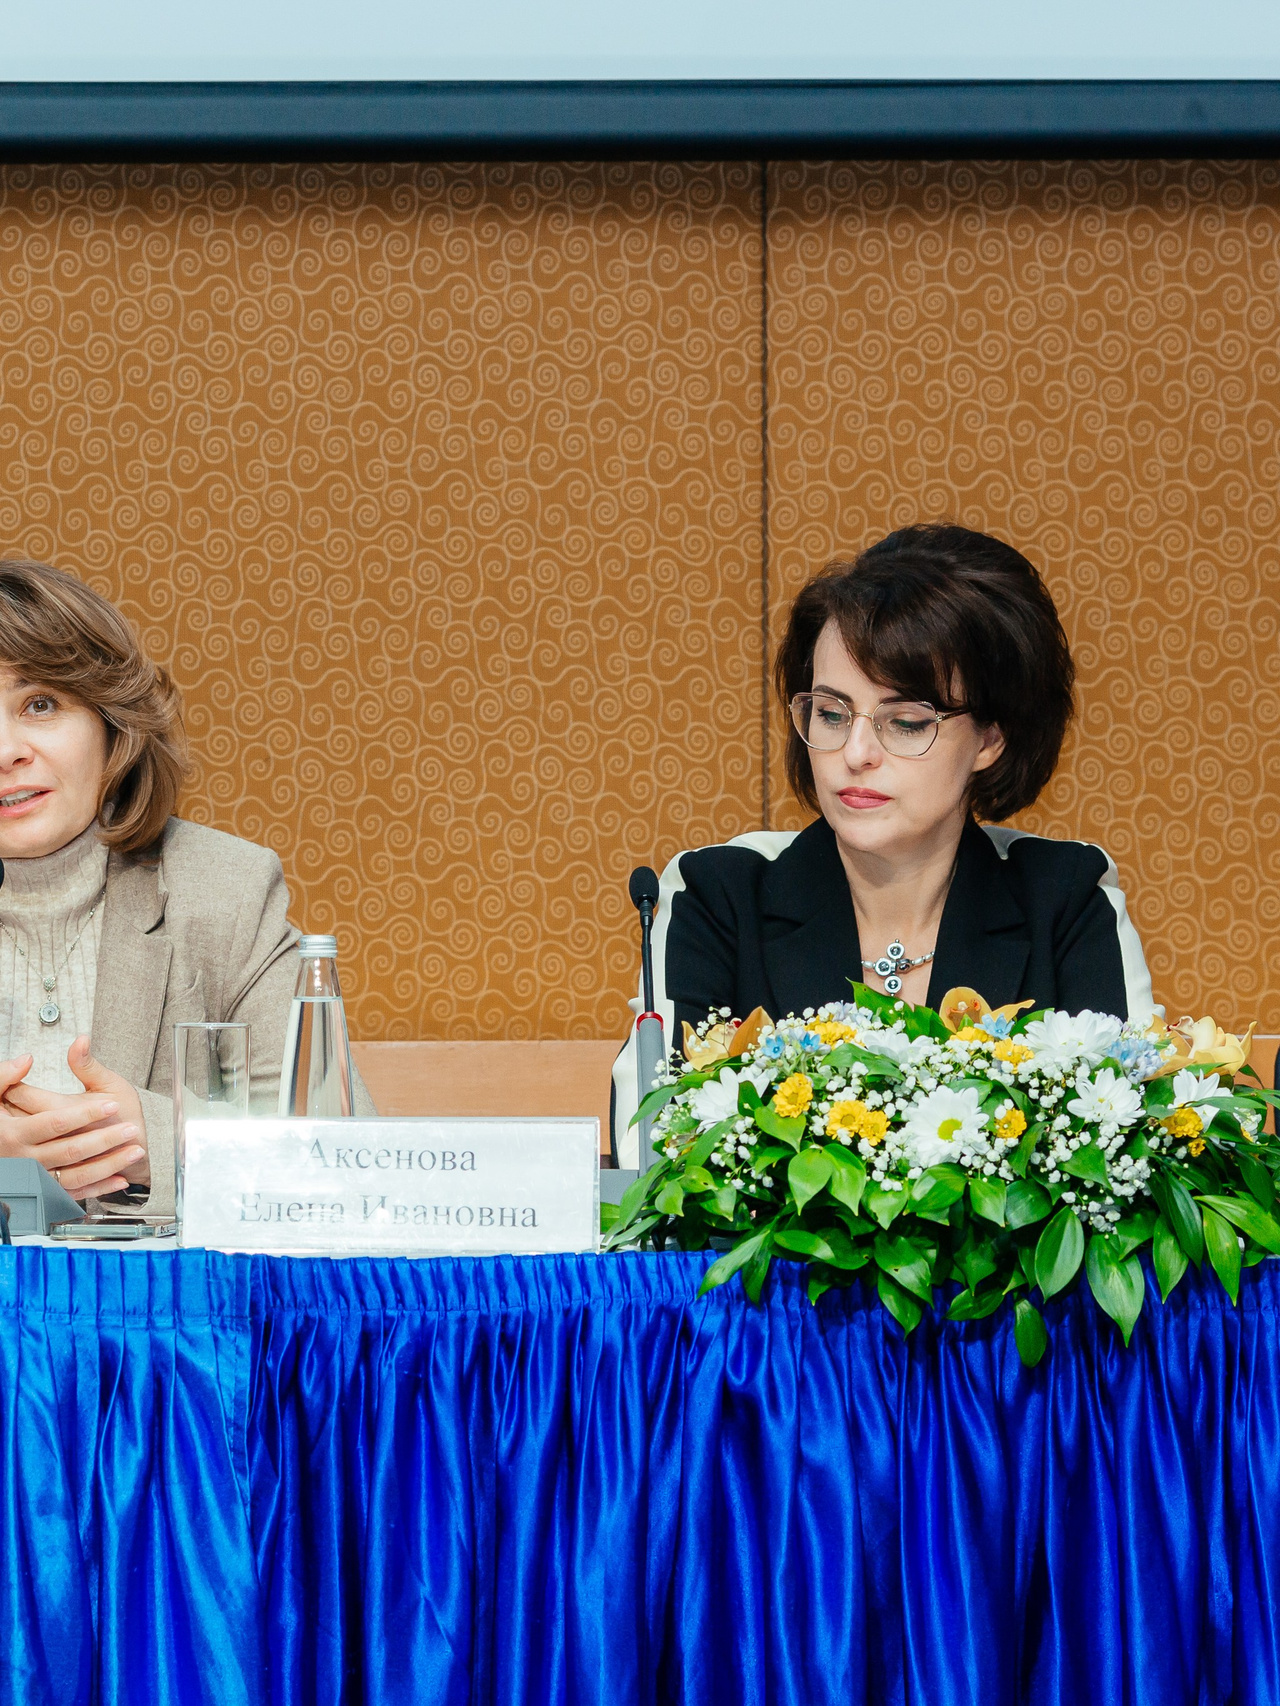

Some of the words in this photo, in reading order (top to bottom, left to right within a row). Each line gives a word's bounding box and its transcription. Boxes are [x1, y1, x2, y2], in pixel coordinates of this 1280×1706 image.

[304, 1138, 478, 1171] Аксенова
[239, 1193, 346, 1224] Елена
[360, 1194, 539, 1228] Ивановна
